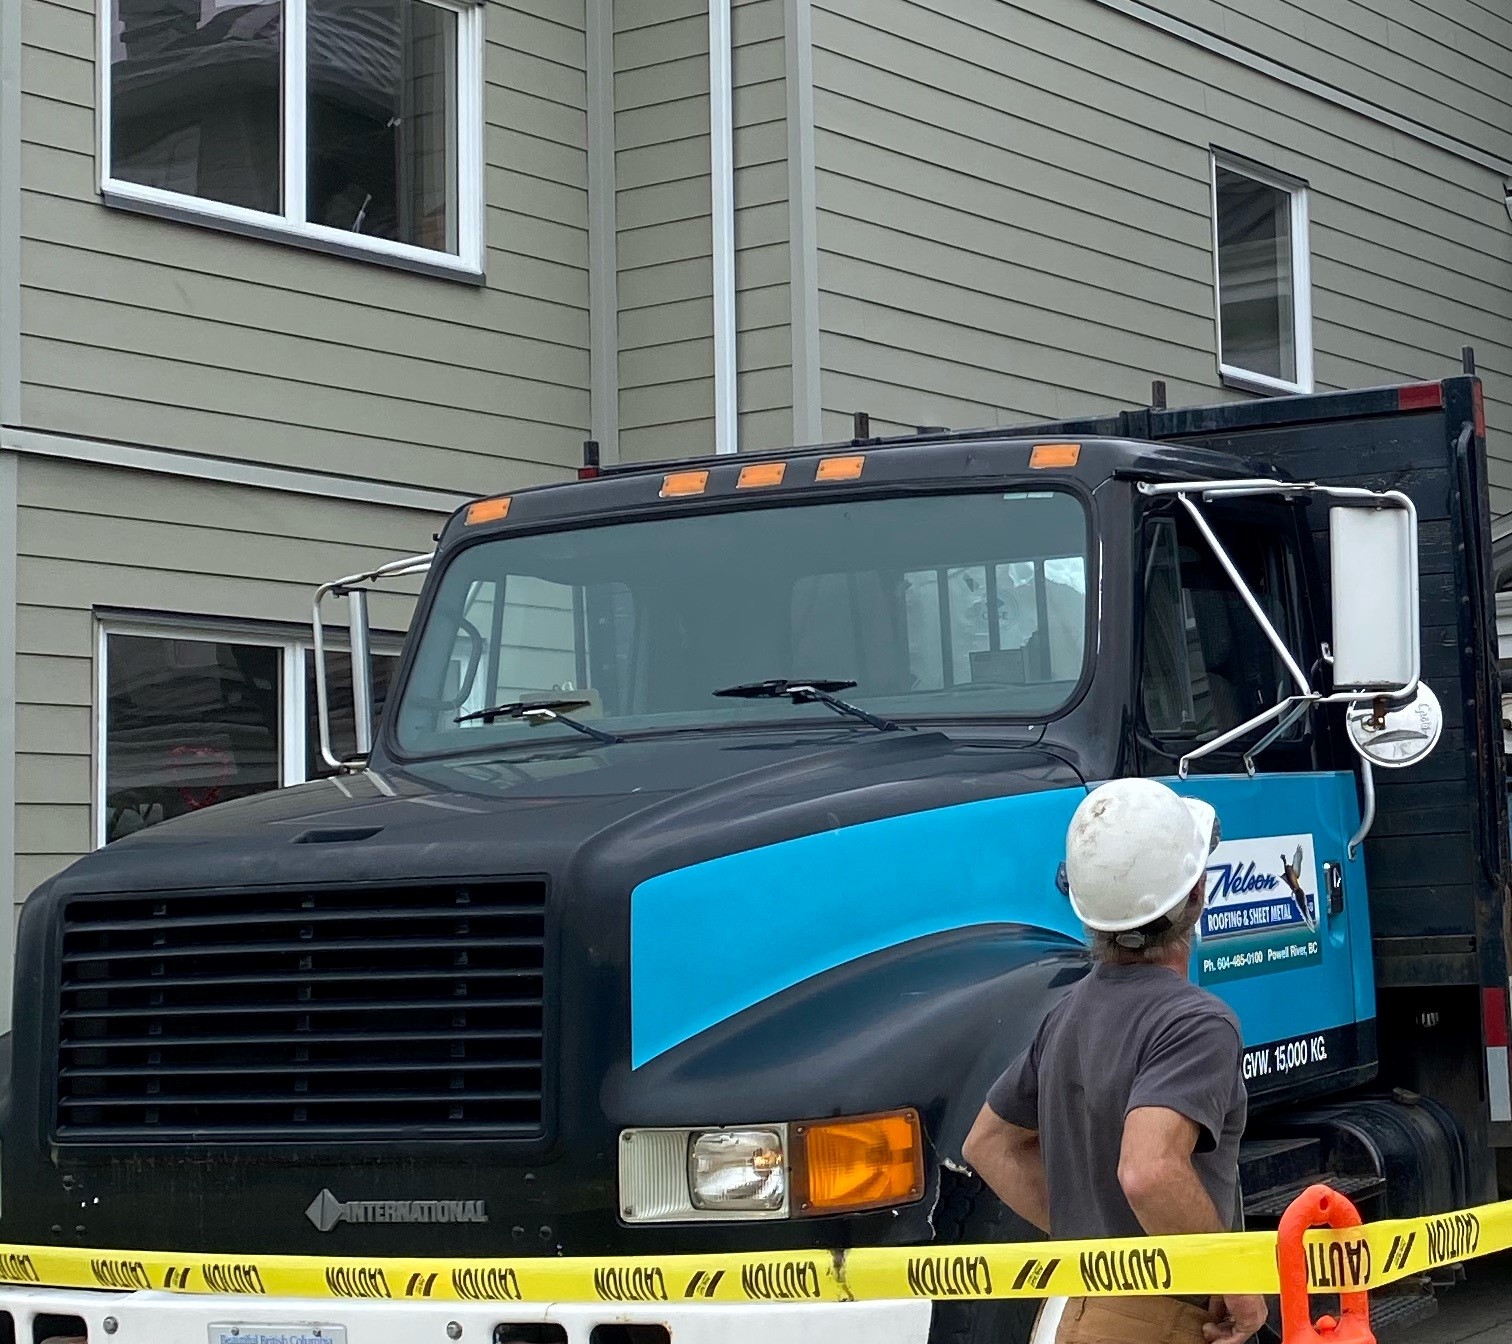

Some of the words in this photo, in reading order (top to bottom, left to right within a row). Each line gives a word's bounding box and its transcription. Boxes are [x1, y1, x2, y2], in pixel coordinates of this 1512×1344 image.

[1206, 861, 1280, 905] Nelson
[1208, 911, 1243, 932] ROOFING
[1243, 910, 1250, 926] &
[1250, 906, 1270, 926] SHEET
[1270, 904, 1293, 922] METAL
[1308, 941, 1318, 954] BC
[1274, 1040, 1308, 1074] 15,000
[345, 1200, 489, 1223] INTERNATIONAL
[1425, 1212, 1480, 1265] CAUTION
[91, 1259, 152, 1289] CAUTION
[203, 1264, 265, 1294] CAUTION
[742, 1261, 821, 1299] CAUTION
[907, 1256, 993, 1296] CAUTION
[1080, 1248, 1171, 1292] CAUTION
[1306, 1238, 1371, 1288] CAUTI
[325, 1267, 392, 1298] CAUTION
[452, 1268, 522, 1300] CAUTION
[594, 1267, 668, 1301] CAUTION
